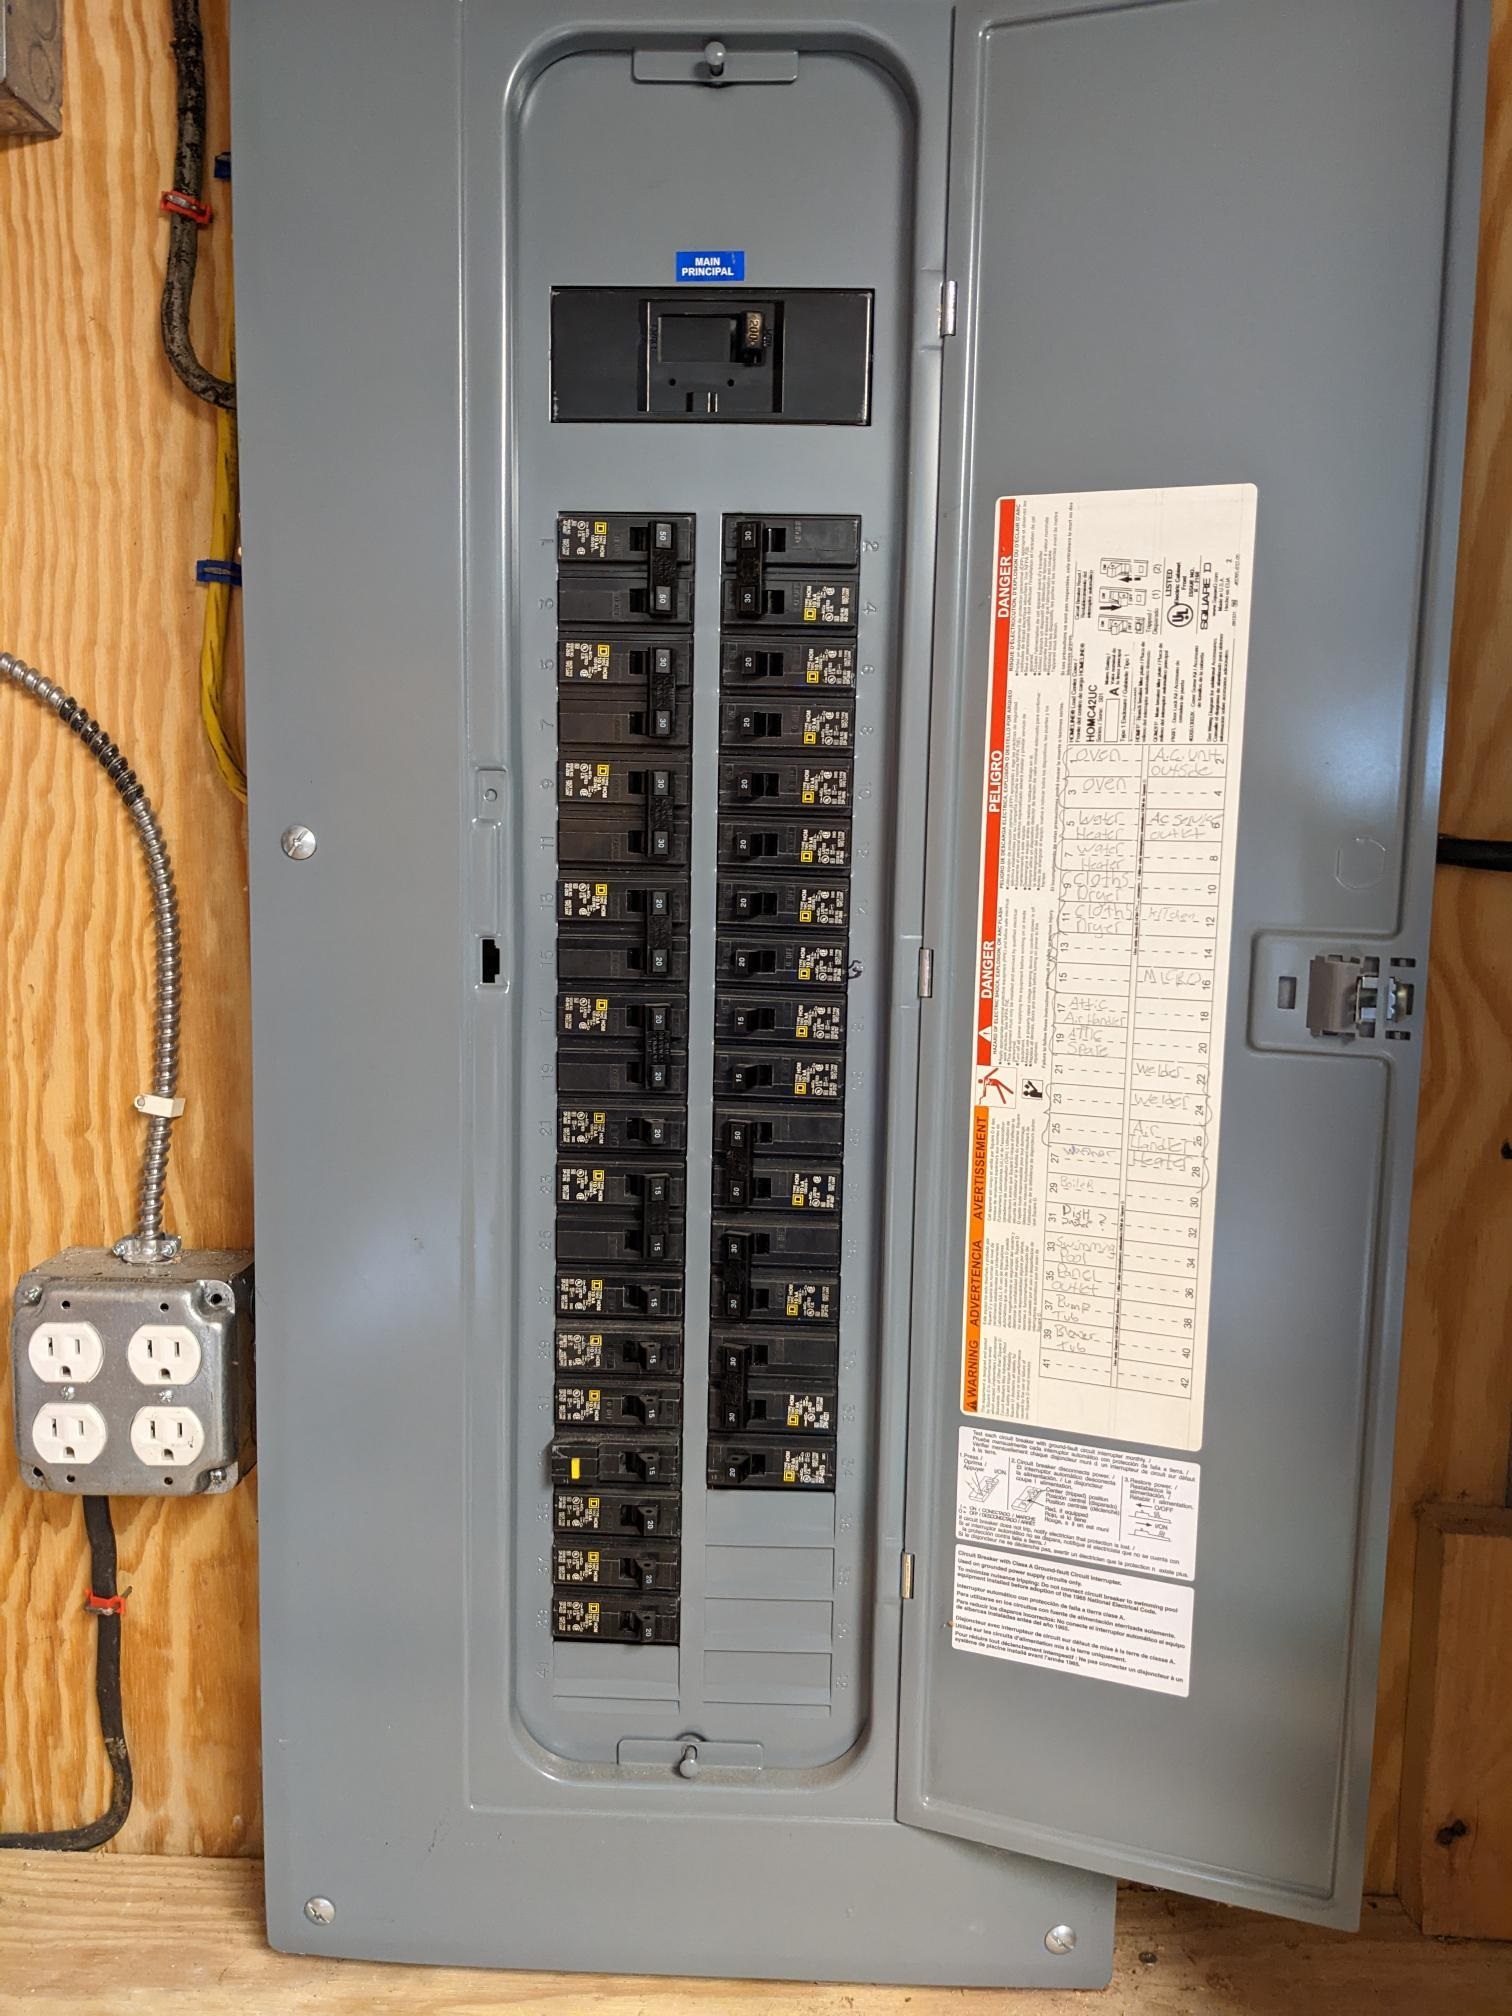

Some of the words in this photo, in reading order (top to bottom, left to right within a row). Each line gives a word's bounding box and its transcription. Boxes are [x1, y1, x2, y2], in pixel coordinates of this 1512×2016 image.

[695, 257, 720, 266] MAIN
[681, 267, 735, 276] PRINCIPAL
[659, 530, 667, 541] 50
[744, 530, 752, 541] 30
[1153, 564, 1162, 574] (2)
[1203, 562, 1211, 573] D
[998, 556, 1011, 618] DANGER
[659, 593, 667, 604] 50
[744, 593, 752, 603] 30
[1151, 590, 1160, 600] (1)
[1200, 578, 1210, 630] SQUARE
[1172, 608, 1188, 622] UL
[659, 657, 667, 667] 30
[745, 657, 752, 667] 20
[1109, 688, 1119, 696] A
[1086, 685, 1097, 742] HOMC42UC
[659, 718, 667, 728] 30
[743, 717, 751, 728] 20
[657, 778, 665, 789] 30
[741, 779, 748, 789] 20
[989, 750, 1002, 812] PELIGRO
[657, 839, 665, 848] 30
[739, 839, 747, 850] 20
[1208, 885, 1216, 894] 10
[655, 899, 663, 909] 20
[740, 897, 747, 908] 20
[1062, 913, 1069, 921] 11
[1206, 917, 1214, 926] 12
[1060, 943, 1069, 952] 13
[1204, 949, 1212, 958] 14
[655, 956, 663, 967] 20
[738, 957, 746, 967] 20
[981, 940, 994, 998] DANGER
[1059, 973, 1067, 981] 15
[1202, 980, 1210, 989] 16
[1057, 1004, 1065, 1012] 17
[655, 1014, 663, 1024] 20
[737, 1016, 745, 1025] 15
[1200, 1012, 1209, 1021] 18
[1056, 1033, 1064, 1042] 19
[1199, 1043, 1207, 1054] 20
[1055, 1065, 1063, 1074] 21
[654, 1071, 662, 1081] 20
[735, 1073, 743, 1082] 15
[1197, 1074, 1206, 1085] 22
[1053, 1094, 1061, 1104] 23
[1195, 1106, 1203, 1116] 24
[1052, 1123, 1060, 1133] 25
[654, 1128, 662, 1139] 20
[734, 1130, 741, 1140] 50
[1193, 1136, 1202, 1146] 26
[1051, 1153, 1059, 1163] 27
[974, 1116, 986, 1220] AVERTISSEMENT
[1192, 1167, 1200, 1177] 28
[654, 1186, 662, 1195] 15
[732, 1186, 740, 1197] 50
[1050, 1183, 1057, 1193] 29
[1190, 1197, 1198, 1207] 30
[1048, 1213, 1056, 1222] 31
[1188, 1228, 1197, 1238] 32
[654, 1242, 661, 1251] 15
[730, 1243, 738, 1253] 30
[1047, 1242, 1055, 1251] 33
[1187, 1258, 1195, 1268] 34
[1046, 1271, 1054, 1280] 35
[969, 1240, 982, 1326] ADVERTENCIA
[1185, 1288, 1193, 1298] 36
[650, 1298, 658, 1307] 15
[730, 1299, 737, 1309] 30
[1045, 1300, 1053, 1310] 37
[1184, 1319, 1192, 1328] 38
[1044, 1329, 1051, 1339] 39
[1182, 1348, 1190, 1358] 40
[649, 1354, 657, 1364] 15
[729, 1356, 737, 1367] 30
[1043, 1359, 1050, 1368] 41
[968, 1340, 978, 1398] WARNING
[1181, 1378, 1189, 1388] 42
[648, 1409, 656, 1419] 15
[728, 1412, 736, 1422] 30
[649, 1466, 656, 1476] 15
[729, 1467, 736, 1478] 20
[647, 1520, 654, 1530] 20
[957, 1550, 976, 1558] Circuit
[999, 1557, 1011, 1565] with
[1012, 1559, 1028, 1568] Class
[645, 1574, 653, 1584] 20
[645, 1627, 652, 1637] 20
